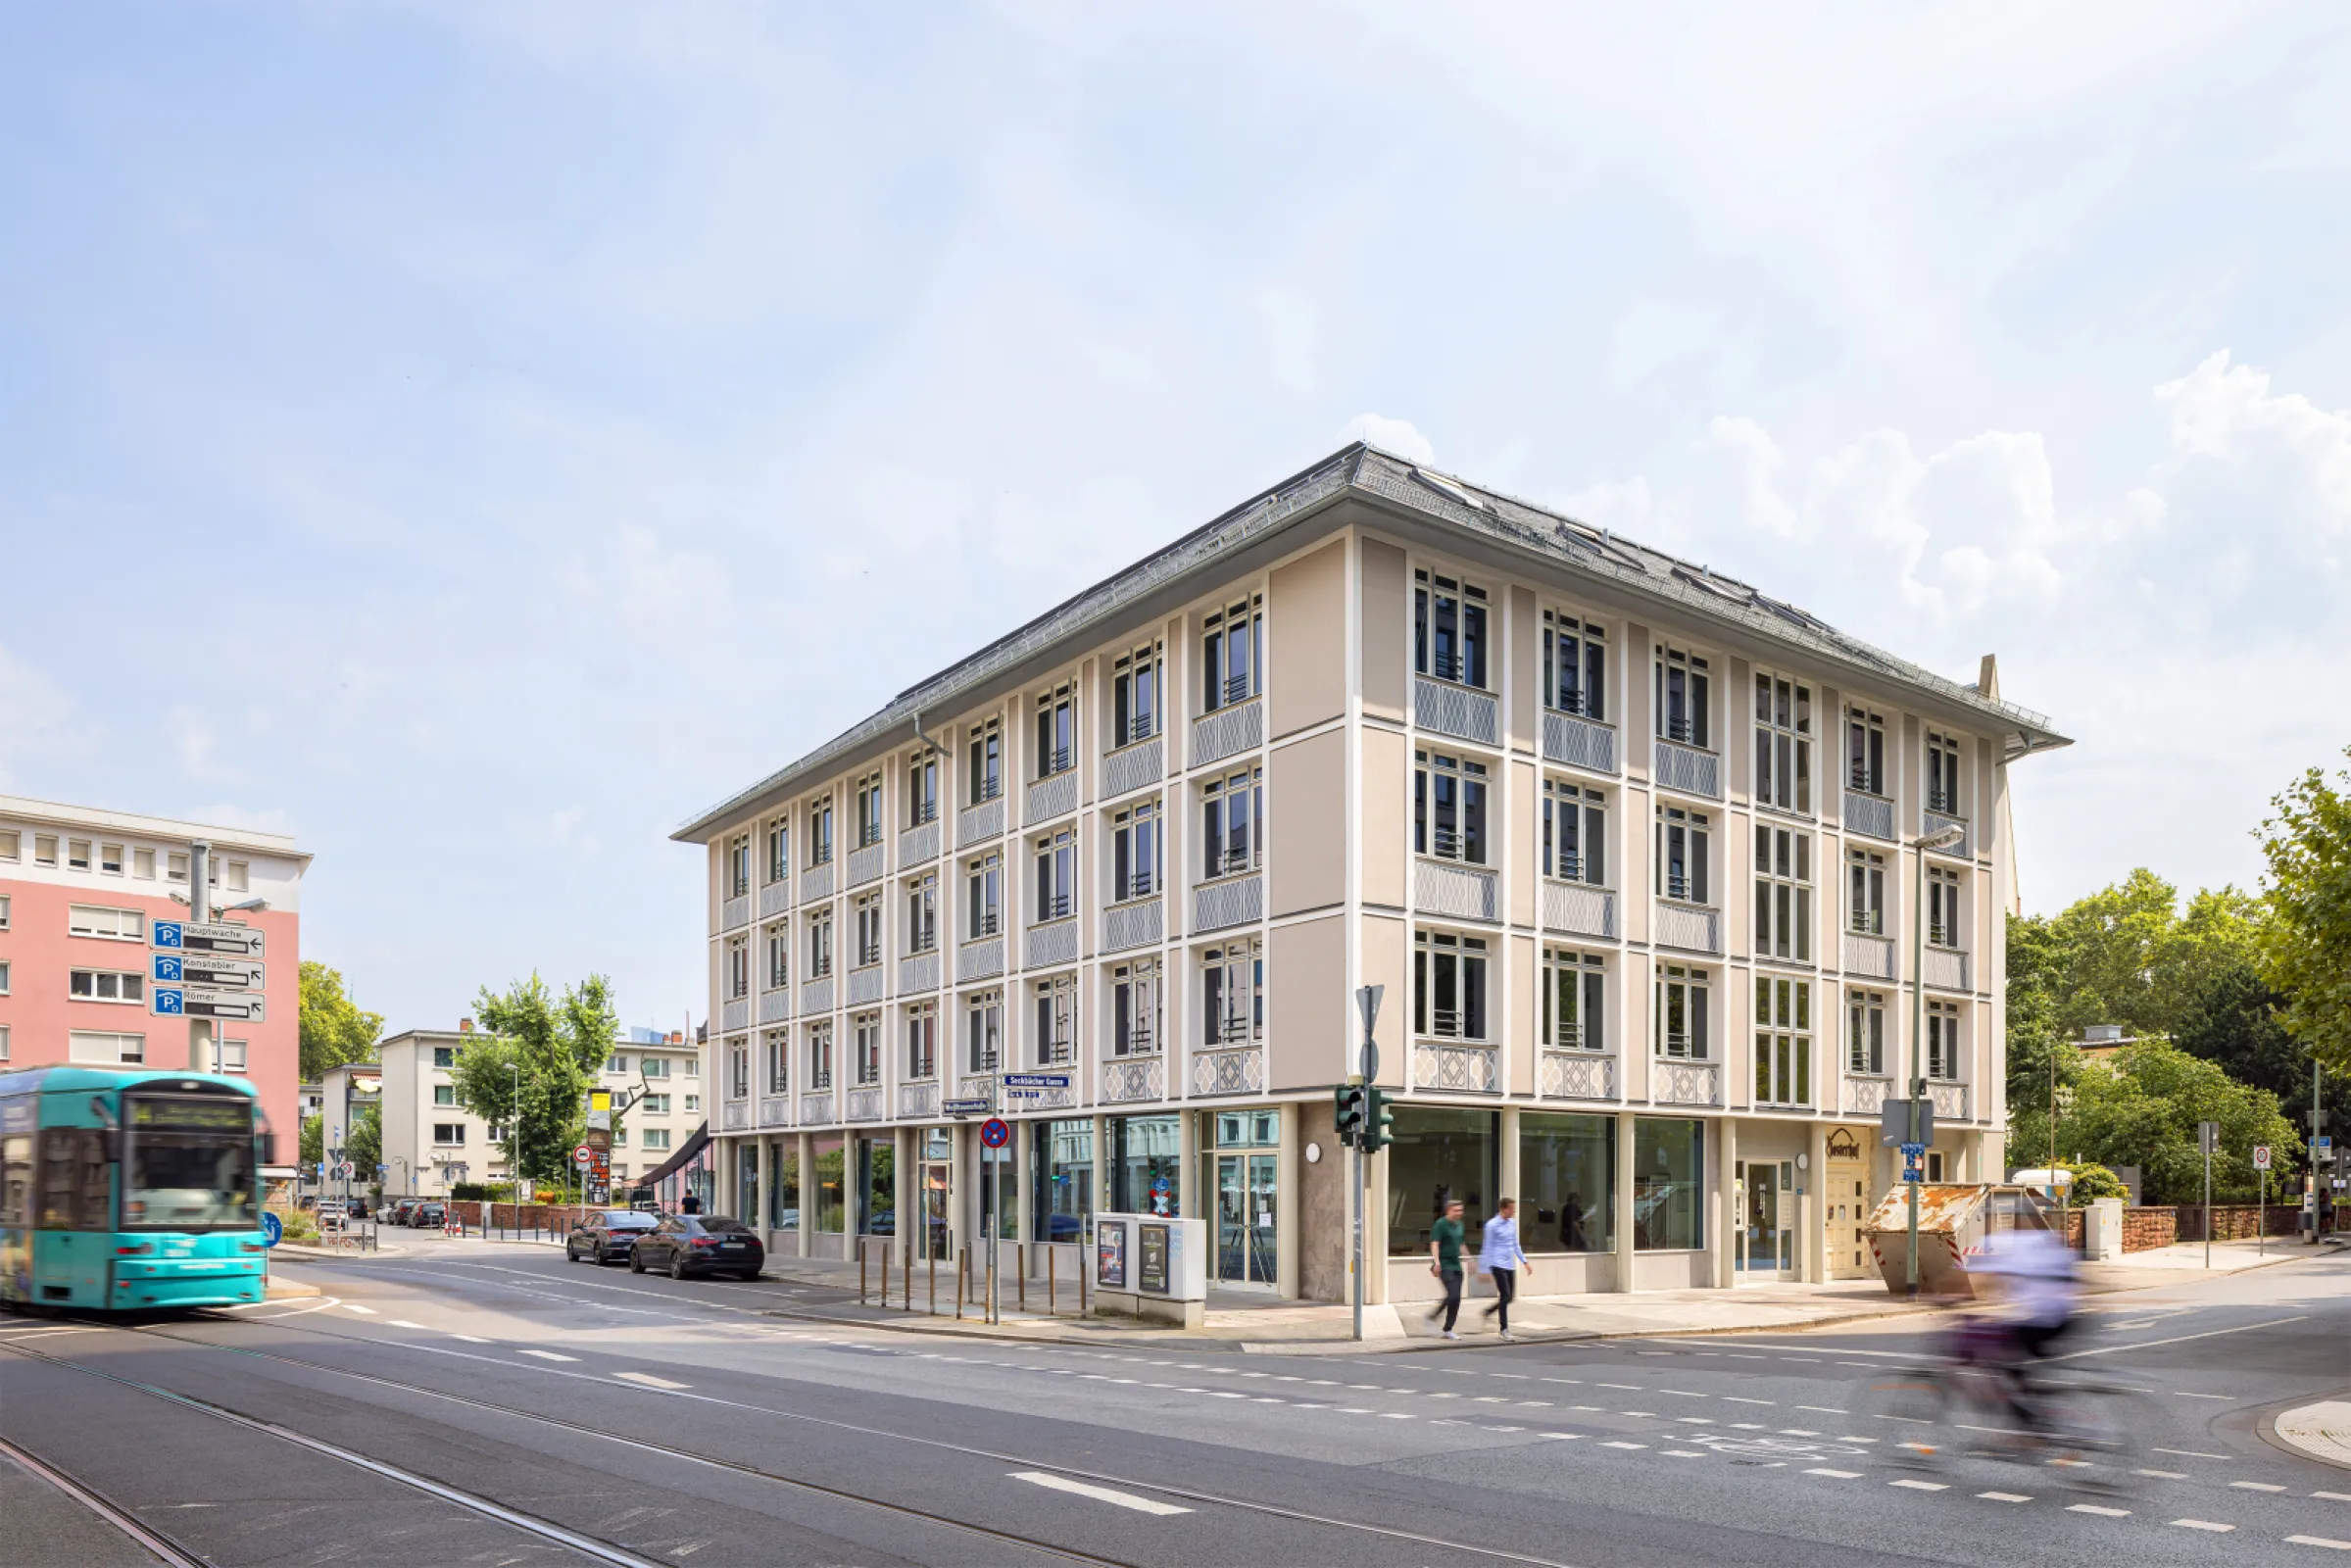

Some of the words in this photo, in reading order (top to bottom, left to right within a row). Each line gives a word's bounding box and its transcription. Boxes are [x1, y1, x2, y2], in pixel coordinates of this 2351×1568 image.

[183, 925, 242, 939] Hauptwache
[183, 957, 235, 970] Konstabler
[183, 990, 216, 1002] Römer
